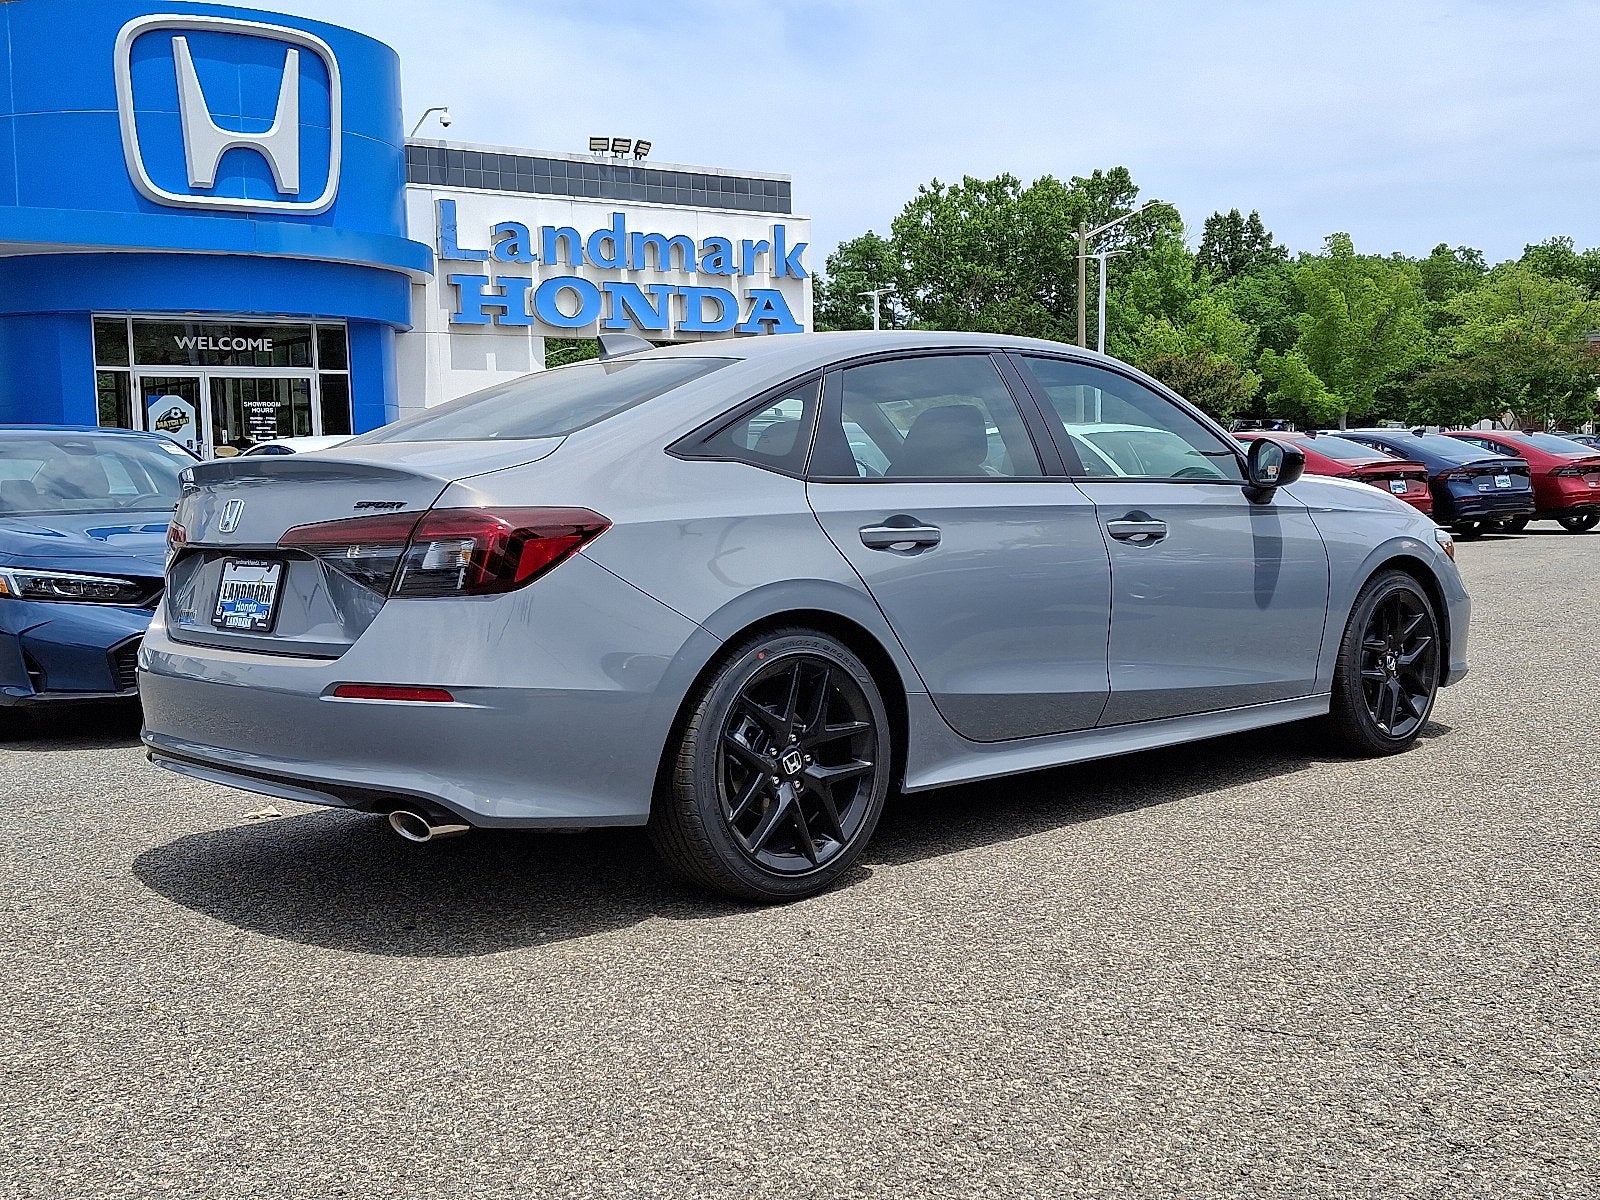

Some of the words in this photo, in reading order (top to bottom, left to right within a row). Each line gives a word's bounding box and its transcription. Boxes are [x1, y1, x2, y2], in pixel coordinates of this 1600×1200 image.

[436, 199, 809, 279] Landmark
[447, 274, 804, 334] HONDA
[173, 335, 274, 352] WELCOME
[353, 501, 408, 511] SPORT
[222, 582, 274, 604] LANDMARK
[234, 600, 257, 613] Honda
